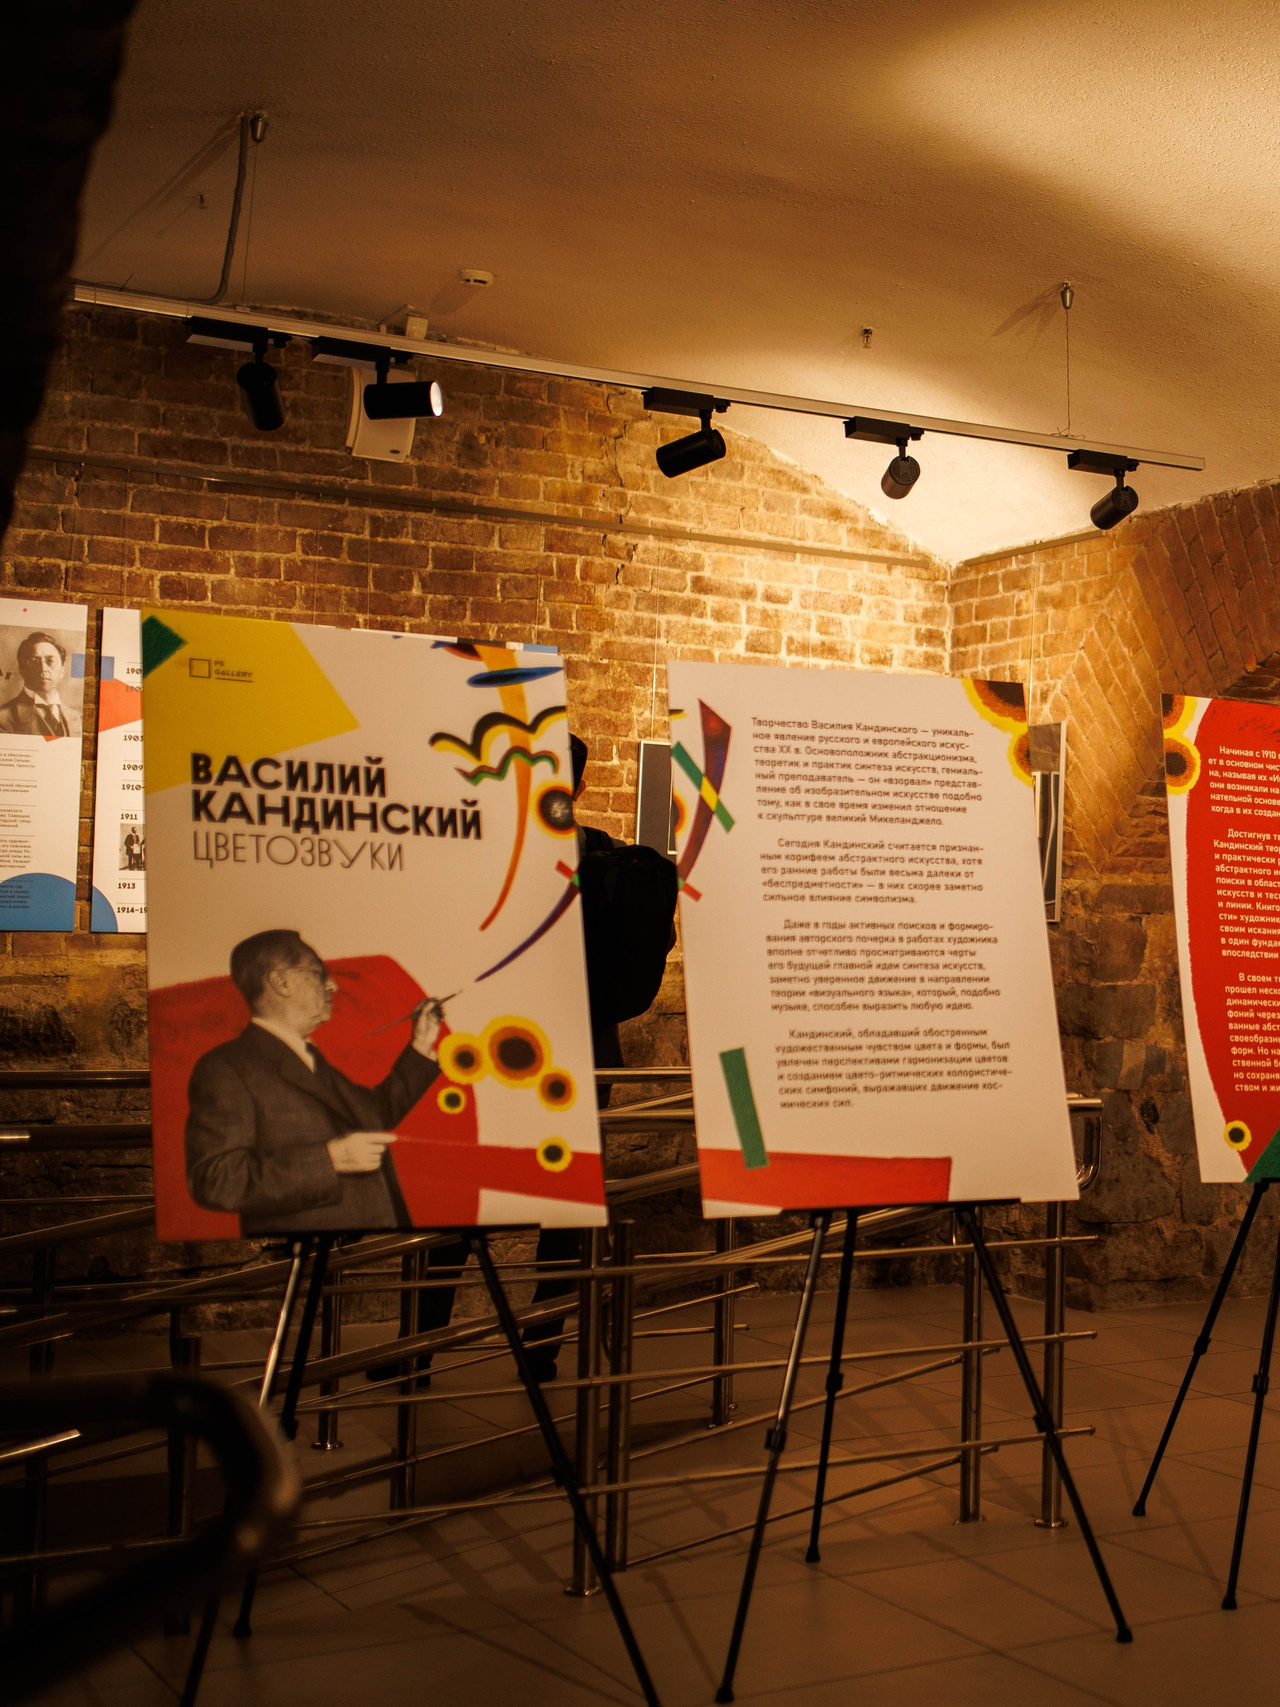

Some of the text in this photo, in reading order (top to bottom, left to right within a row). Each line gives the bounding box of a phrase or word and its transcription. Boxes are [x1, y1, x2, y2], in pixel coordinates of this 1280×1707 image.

[126, 667, 143, 675] 190
[213, 668, 253, 678] GALLERY
[752, 732, 771, 740] ное
[773, 733, 816, 742] явление
[817, 735, 861, 744] русского
[871, 738, 937, 748] европейского
[938, 742, 969, 751] искус-
[1219, 746, 1254, 756] Начиная
[1261, 750, 1277, 759] 1910
[122, 763, 144, 771] 1909
[754, 759, 800, 767] теоретик
[811, 761, 852, 769] практик
[854, 763, 893, 771] синтеза
[941, 767, 983, 775] гениаль-
[1225, 760, 1264, 769] основном
[190, 752, 387, 799] ВАСИЛИЙ
[1208, 770, 1221, 778] на,
[1222, 771, 1256, 780] называя
[1209, 781, 1225, 789] они
[1226, 783, 1269, 792] возникали
[788, 785, 802, 794] об
[803, 786, 890, 797] изобразительном
[892, 791, 940, 800] искусстве
[941, 792, 982, 801] подобно
[1210, 793, 1253, 803] нательной
[838, 802, 869, 810] время
[870, 803, 912, 811] изменил
[914, 805, 967, 813] отношение
[1210, 805, 1234, 814] когда
[120, 813, 138, 821] 1911
[190, 788, 482, 841] КАНДИНСКИЙ
[765, 813, 823, 823] скульптуре
[825, 814, 867, 822] великий
[1227, 828, 1271, 841] Достигнув
[777, 838, 984, 852] Сегодня Кандинский считается признан-
[1213, 839, 1264, 851] Кандинский
[192, 829, 404, 872] ЦВЕТОЗВУКИ
[784, 853, 836, 862] корифеем
[837, 853, 905, 863] абстрактного
[1221, 853, 1276, 863] практически
[760, 866, 778, 874] его
[780, 867, 818, 875] ранние
[820, 866, 858, 876] работы
[859, 867, 886, 876] были
[888, 869, 924, 877] весьма
[926, 870, 962, 878] далеки
[1214, 864, 1272, 875] абстрактного
[117, 882, 136, 890] 1913
[1215, 877, 1246, 885] поиски
[1216, 889, 1255, 898] искусств
[1225, 901, 1254, 909] линии.
[1239, 915, 1280, 923] художник
[1219, 925, 1246, 933] своим
[1227, 937, 1250, 946] один
[1221, 949, 1279, 959] впоследствии
